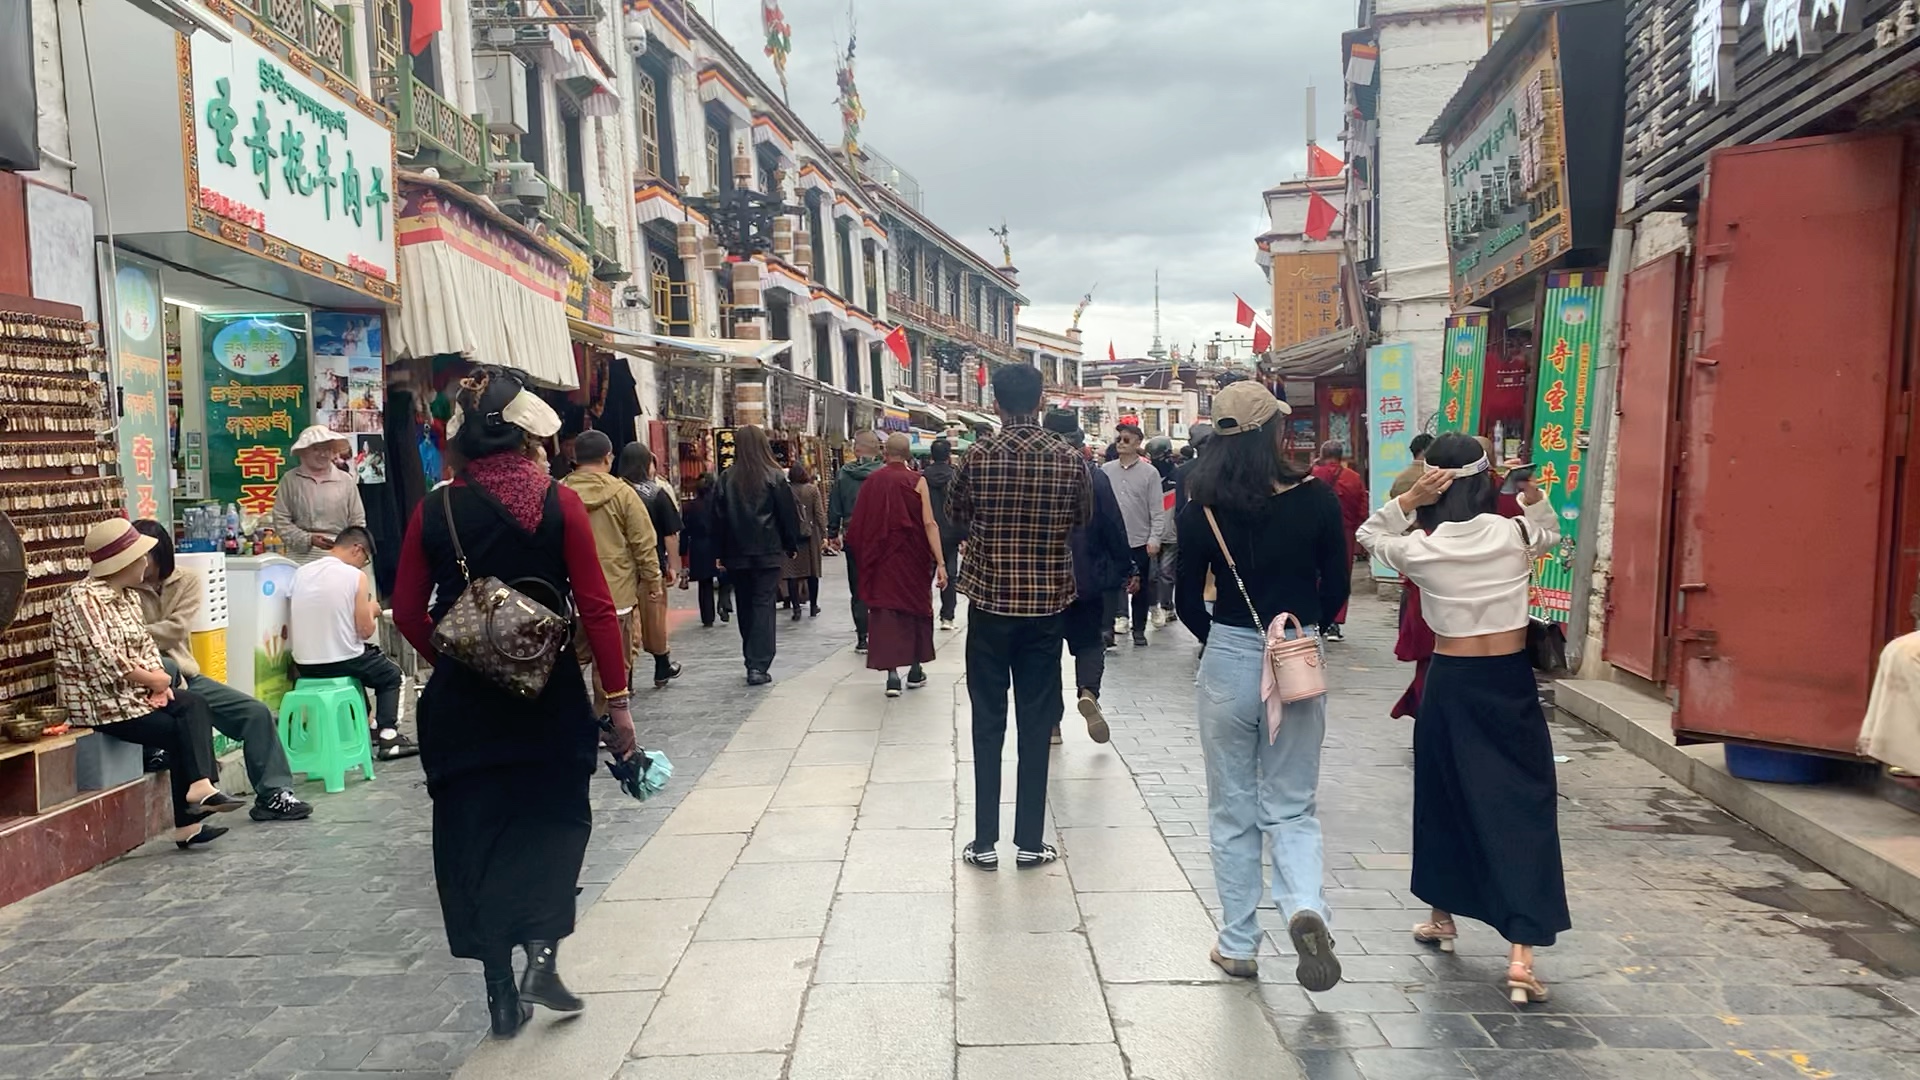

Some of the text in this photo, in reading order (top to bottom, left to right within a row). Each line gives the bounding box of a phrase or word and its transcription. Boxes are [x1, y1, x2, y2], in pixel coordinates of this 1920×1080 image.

[132, 433, 158, 520] 奇圣
[235, 445, 285, 515] 奇圣
[1534, 337, 1573, 577] 奇圣牦牛干
